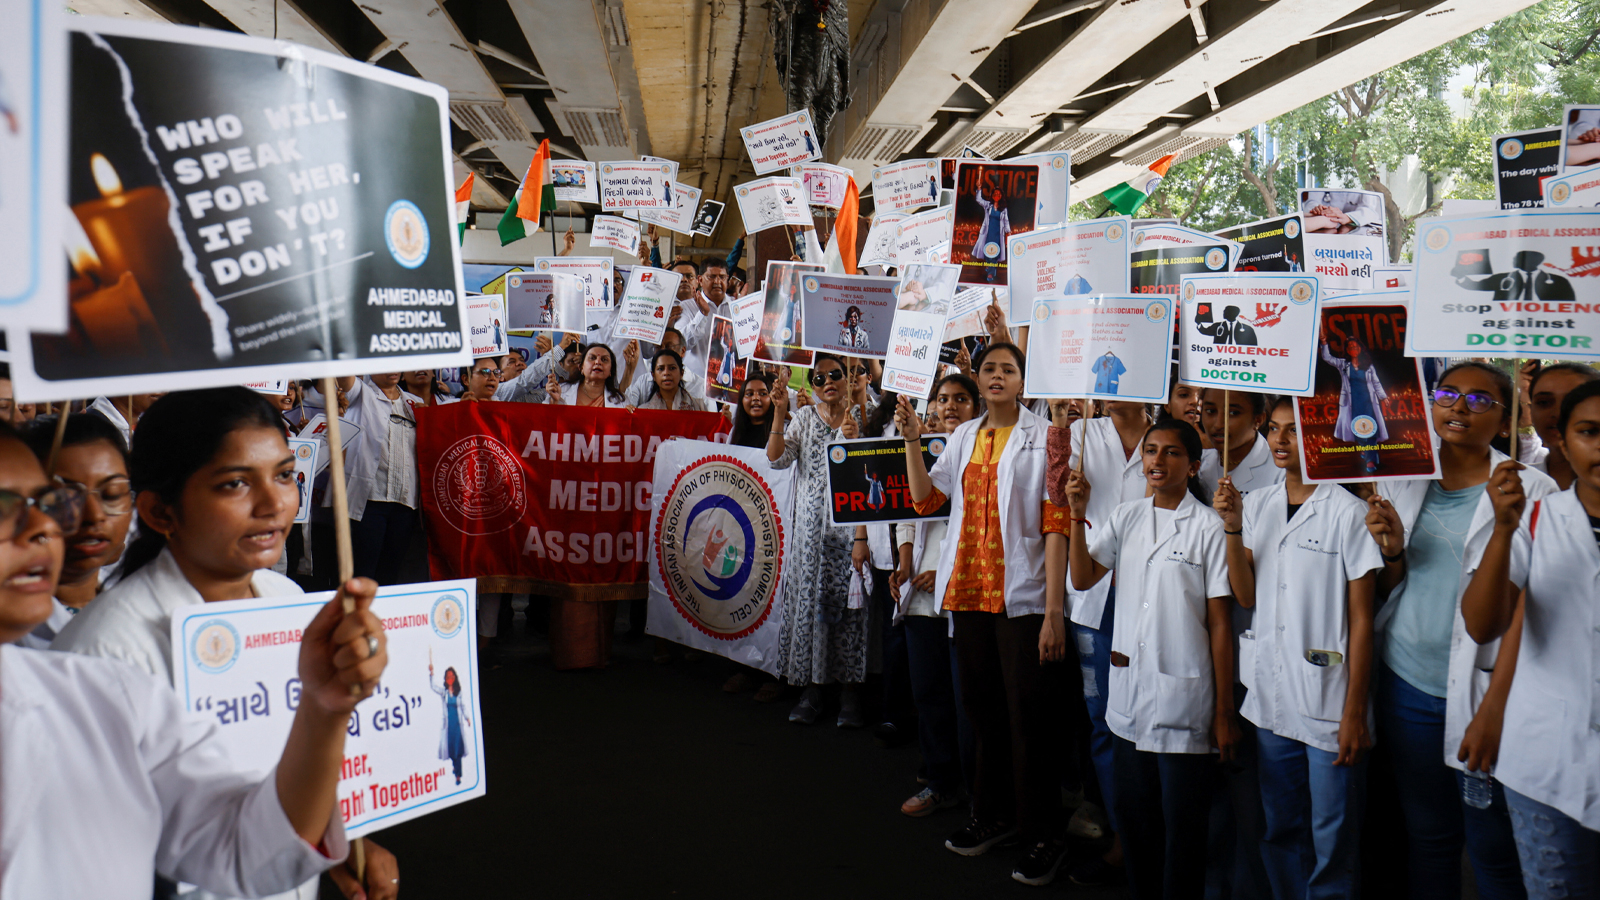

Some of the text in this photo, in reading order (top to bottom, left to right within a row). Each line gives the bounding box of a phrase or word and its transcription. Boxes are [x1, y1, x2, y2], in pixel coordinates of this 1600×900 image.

[156, 98, 347, 152] WHO WILL
[173, 138, 303, 185] SPEAK
[1519, 168, 1538, 176] day
[185, 162, 361, 219] FOR HER,
[959, 169, 1037, 199] JUSTICE
[198, 196, 340, 252] IF YOU
[210, 228, 347, 286] DON'T?
[1261, 251, 1282, 260] turned
[1315, 247, 1373, 260] બચાવનારને
[1037, 260, 1047, 268] STOP
[1037, 266, 1056, 276] VIOLENCE
[1037, 274, 1054, 284] AGAINST
[368, 287, 455, 307] AHMEDABAD
[1245, 288, 1287, 296] ASSOCIATION
[1106, 307, 1144, 315] ASSOCIATION
[1442, 303, 1492, 315] Stop
[383, 310, 446, 329] MEDICAL
[1482, 317, 1576, 330] against
[1062, 330, 1075, 338] STOP
[1322, 313, 1406, 353] STICE
[1466, 333, 1593, 349] DOCTOR
[369, 332, 461, 353] ASSOCIATION
[473, 345, 496, 354] Injustice"
[1061, 338, 1085, 346] VIOLENCE
[1061, 347, 1081, 355] AGAINST
[1191, 344, 1290, 357] Stop VIOLENCE
[1208, 357, 1257, 367] against
[1201, 368, 1267, 383] DOCTOR
[1382, 400, 1425, 417] KAR
[1321, 445, 1355, 454] Ahmedabad
[1356, 444, 1380, 452] Medical
[437, 462, 451, 507] AHMEDABAD
[447, 438, 480, 462] MEDICAL
[483, 439, 518, 473] ASSOCIATION
[886, 474, 909, 488] ALL
[549, 480, 652, 512] MEDIC
[522, 526, 648, 564] ASSOCI
[667, 470, 774, 624] THE INDIAN ASSOCIATION OF PHYSIOTHERAPISTS WOMEN CELL
[245, 613, 429, 649] AHMEDAB SOCIATION
[195, 681, 270, 725] “સાથે
[341, 753, 372, 781] her,
[340, 766, 445, 823] ght Together"
